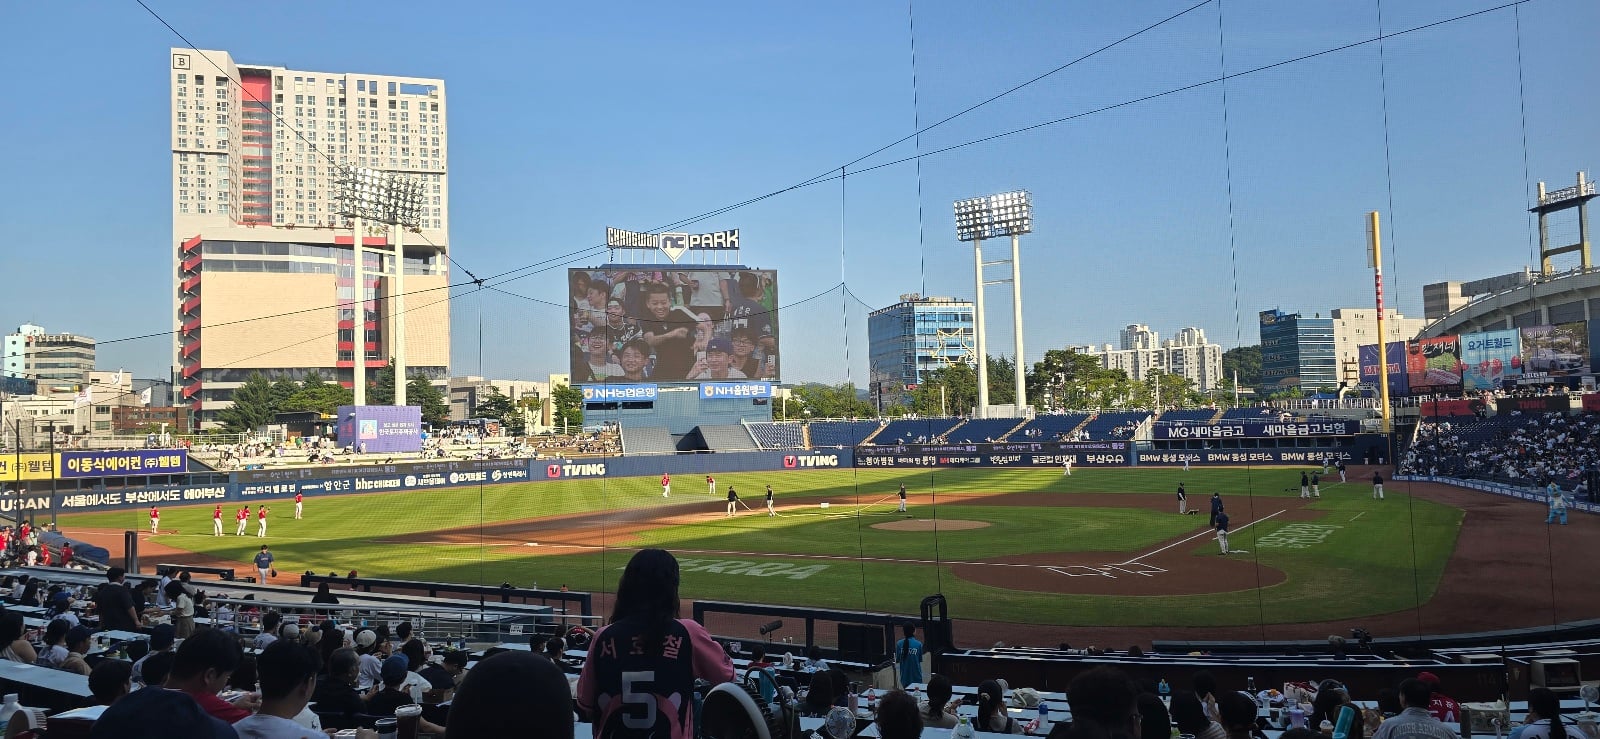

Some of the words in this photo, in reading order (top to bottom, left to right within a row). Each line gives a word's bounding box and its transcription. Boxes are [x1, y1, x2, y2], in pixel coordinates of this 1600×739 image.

[178, 57, 186, 66] B
[607, 226, 659, 248] CHANGWON
[689, 230, 739, 248] PARK
[1468, 338, 1512, 350] 요거트월드
[596, 388, 655, 398] NH농협은행
[798, 455, 838, 467] TVING
[1087, 454, 1124, 464] 부산우유
[1140, 454, 1160, 462] BMW
[1162, 454, 1176, 462] 동성
[1232, 453, 1247, 461] 동성
[1249, 453, 1274, 461] 모터스
[1307, 452, 1323, 461] 동성
[68, 455, 142, 472] 이동식에어컨
[144, 456, 180, 468] (주)웰템
[563, 464, 606, 476] TVING
[458, 472, 487, 481] 요거트월드
[324, 480, 350, 490] 함안군
[355, 478, 374, 490] bhc
[62, 493, 122, 507] 서울에서도
[125, 489, 180, 503] 부산에서도
[184, 487, 225, 499] 에어부산
[600, 635, 683, 660] 서호철
[622, 670, 657, 729] 5
